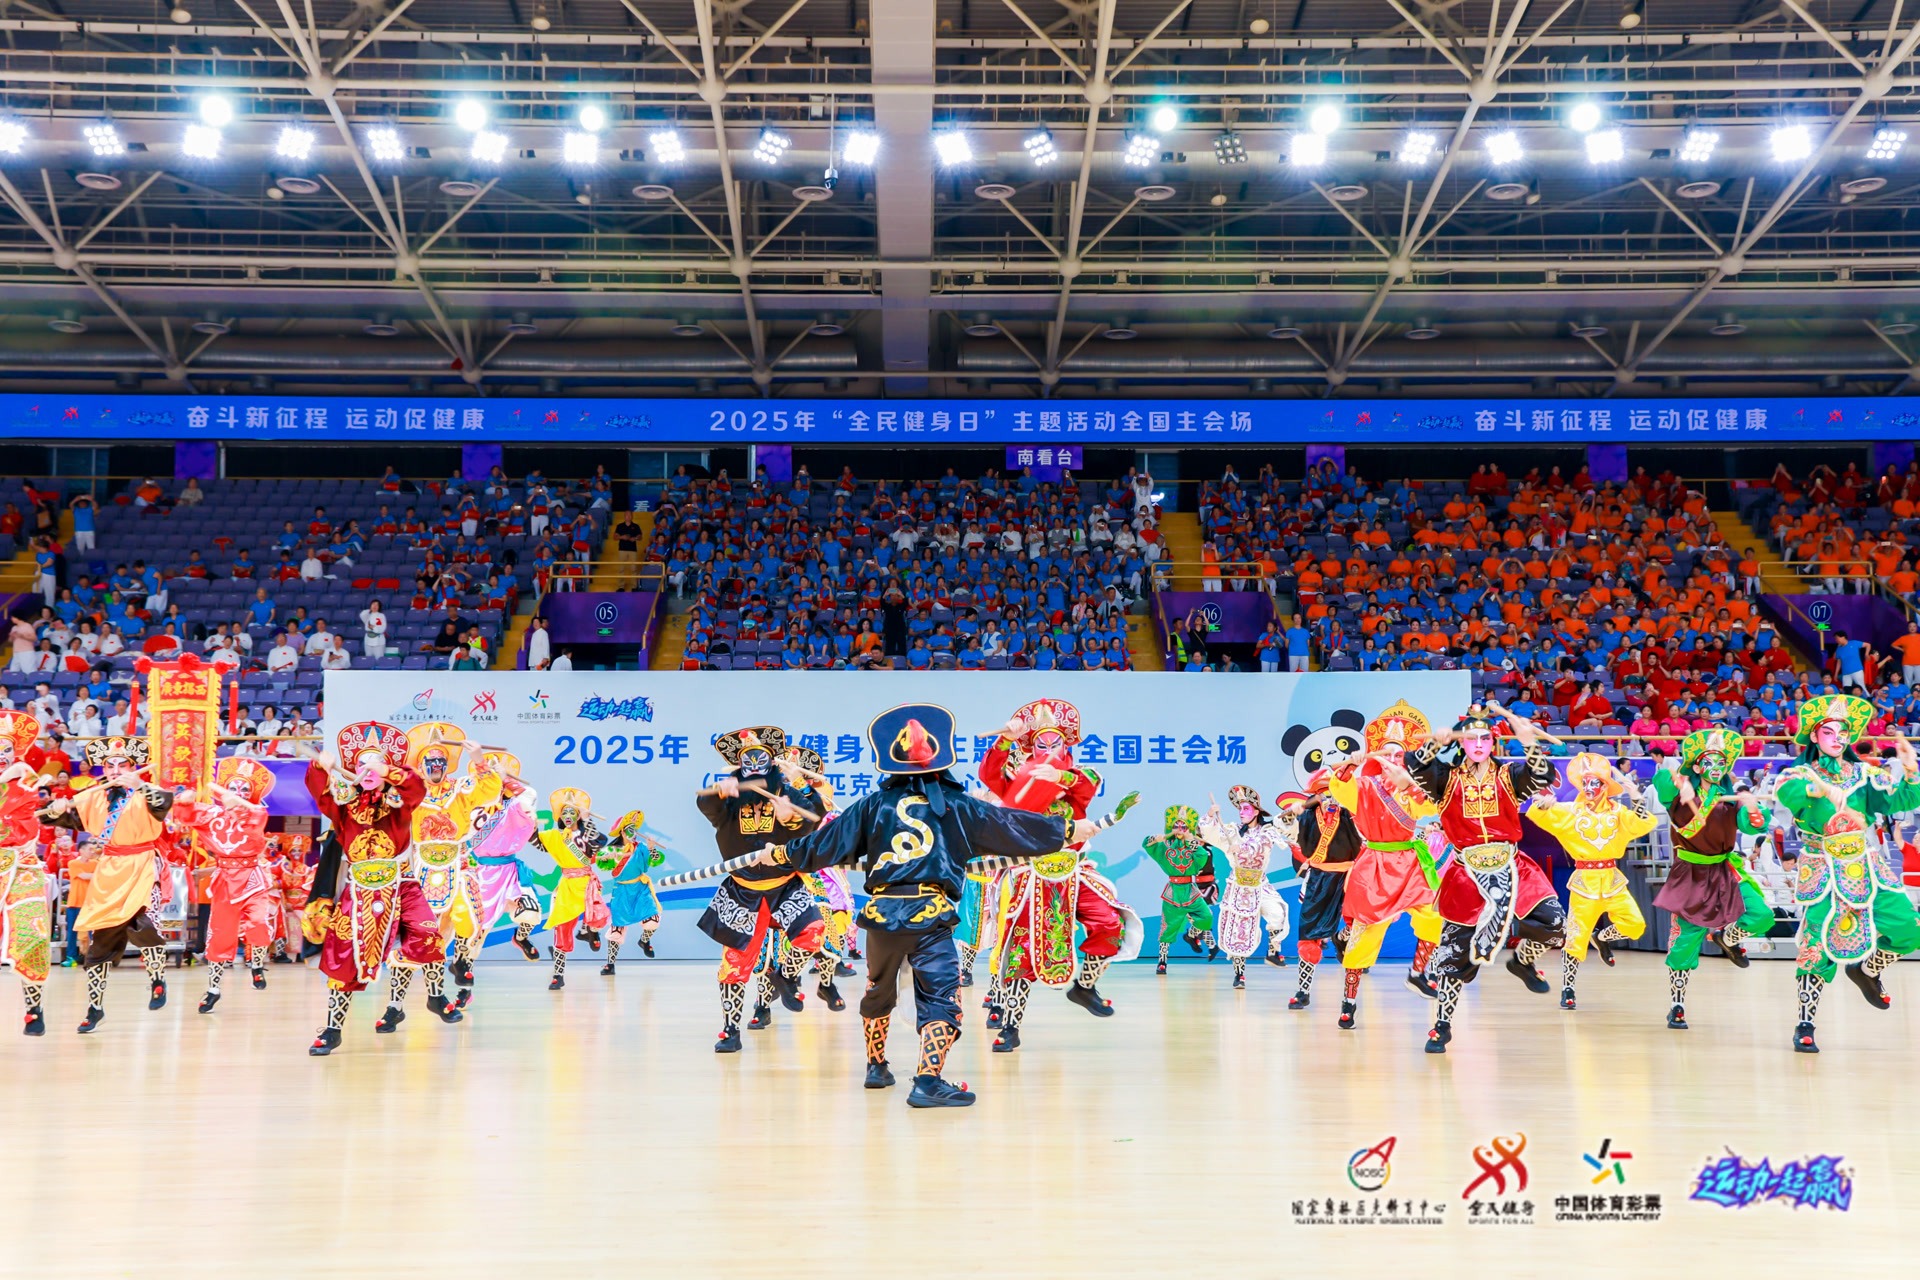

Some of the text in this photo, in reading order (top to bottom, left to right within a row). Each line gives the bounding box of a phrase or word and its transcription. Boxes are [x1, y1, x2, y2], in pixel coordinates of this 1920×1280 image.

[187, 406, 328, 429] 奋斗新征程
[345, 407, 485, 430] 运动促健康
[1474, 409, 1612, 432] 奋斗新征程
[1628, 408, 1768, 431] 运动促健康
[1017, 448, 1073, 466] 南看台
[599, 606, 613, 620] 05
[1203, 607, 1218, 621] 06
[1812, 605, 1827, 619] 07
